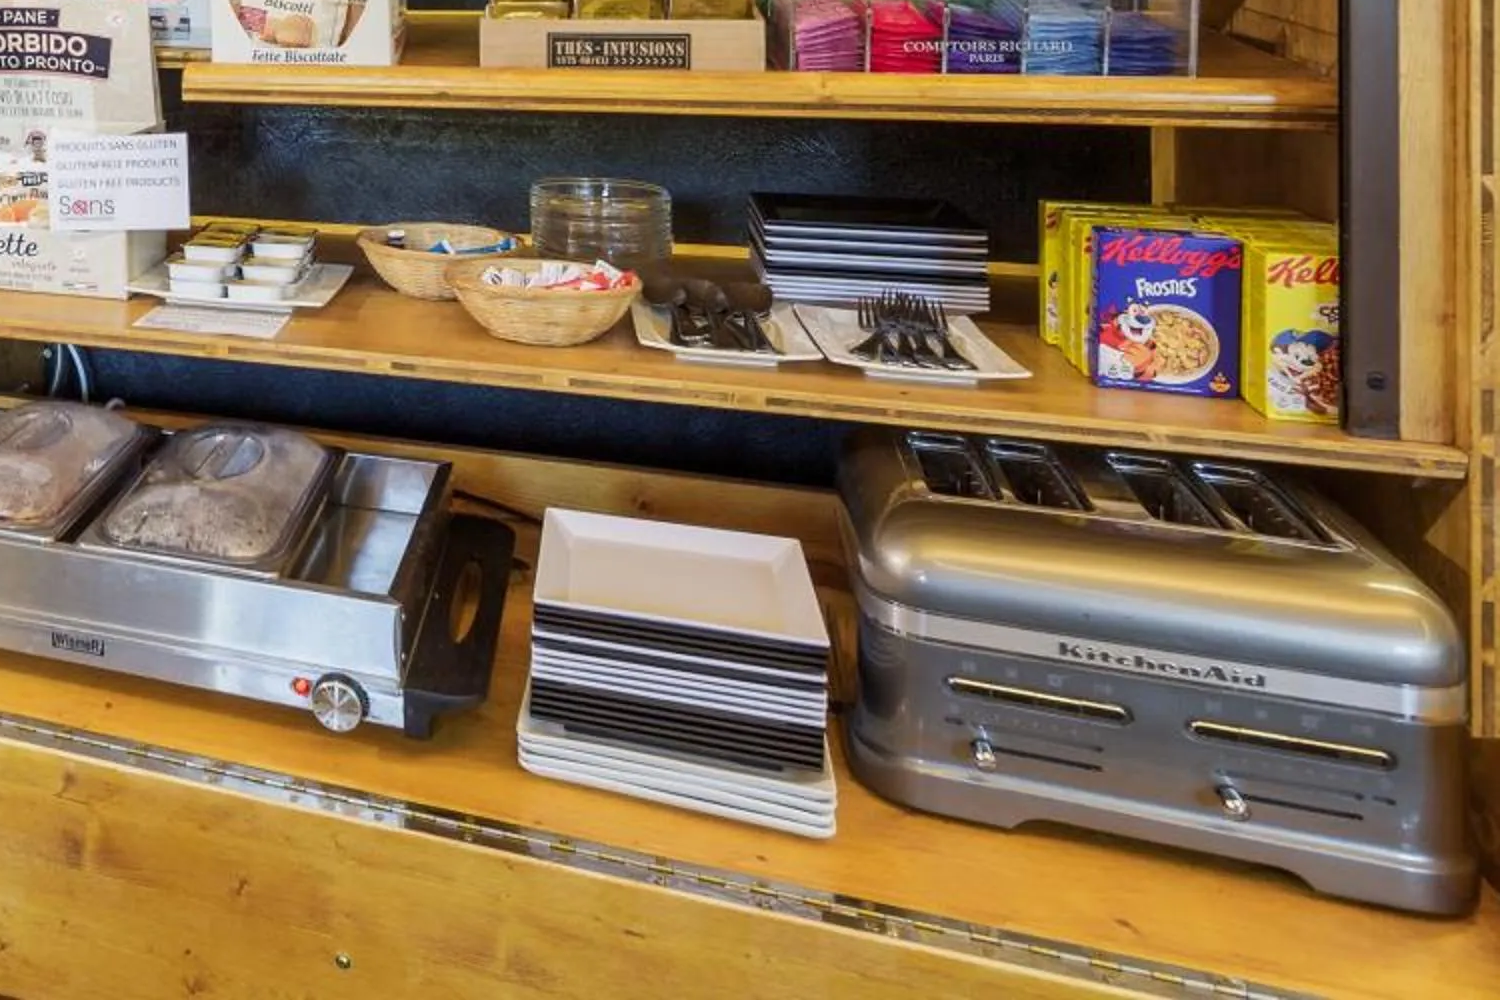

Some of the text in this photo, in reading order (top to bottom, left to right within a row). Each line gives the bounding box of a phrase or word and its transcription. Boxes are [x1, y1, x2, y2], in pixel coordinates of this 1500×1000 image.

[3, 10, 47, 24] PANE
[903, 40, 1073, 53] COMPTOIRS RICHARD
[252, 49, 347, 63] Fette Biscottate
[969, 53, 1005, 63] PARIS
[25, 55, 95, 73] PRONTO
[56, 139, 177, 152] PRODUITS SANS GLUTEN
[125, 158, 179, 168] PRODUKTE
[58, 176, 180, 189] GLUTEN FREE PRODUCTS
[59, 195, 116, 216] Sans
[1135, 277, 1198, 297] FROSTIES
[1058, 641, 1268, 687] KitchenAid
